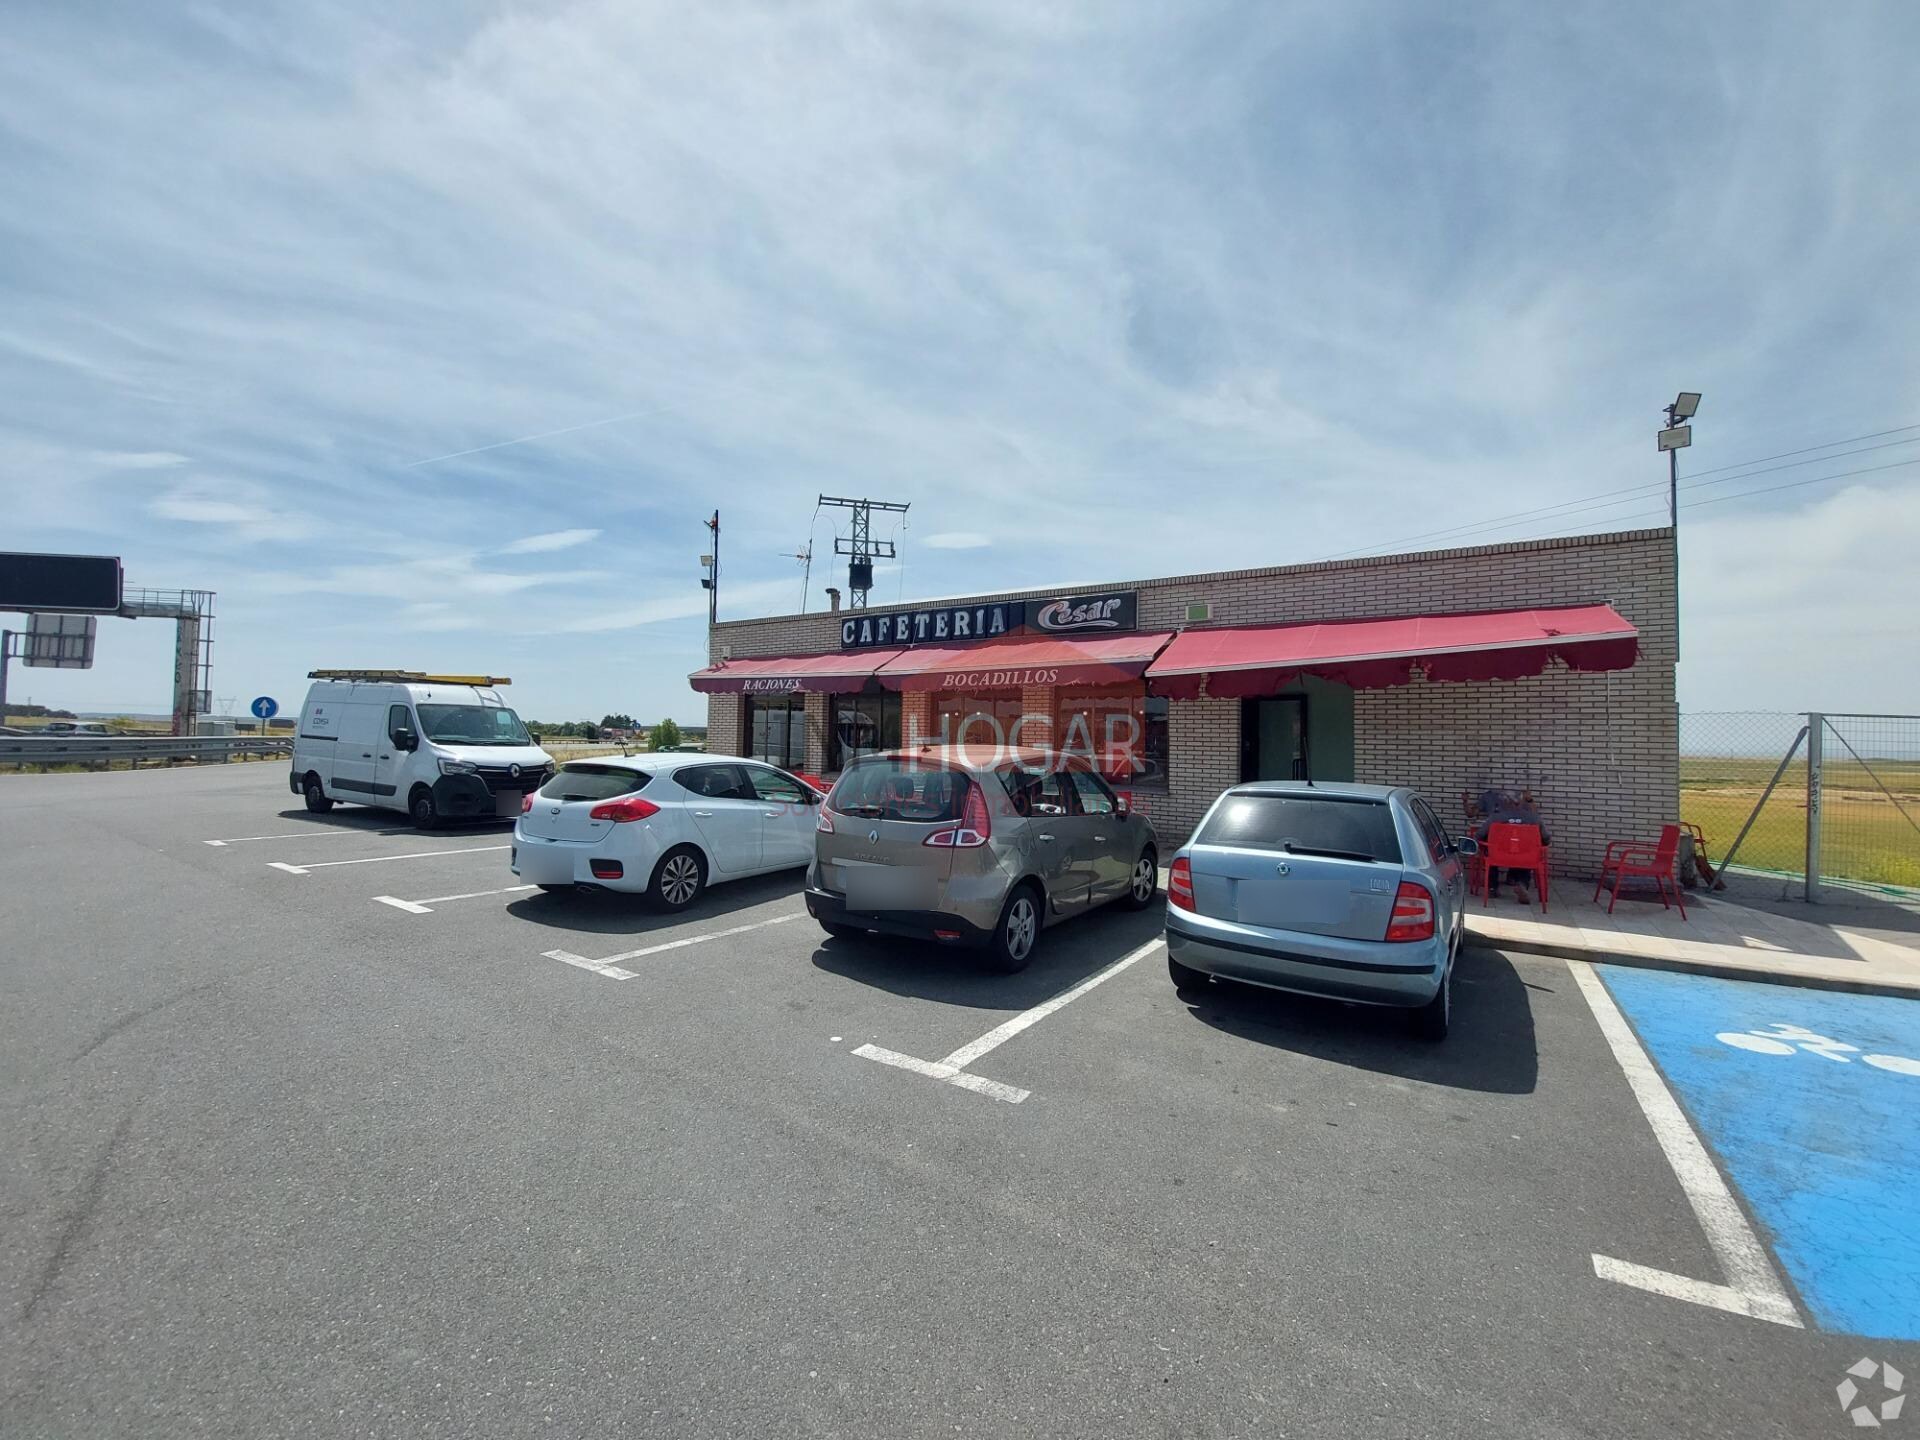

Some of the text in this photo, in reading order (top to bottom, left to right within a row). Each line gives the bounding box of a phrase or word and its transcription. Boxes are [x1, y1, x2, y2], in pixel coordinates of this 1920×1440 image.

[842, 598, 1121, 643] CAFETERIA Cesar
[742, 678, 802, 691] RACIONES
[943, 669, 1059, 687] BOCADILLOS
